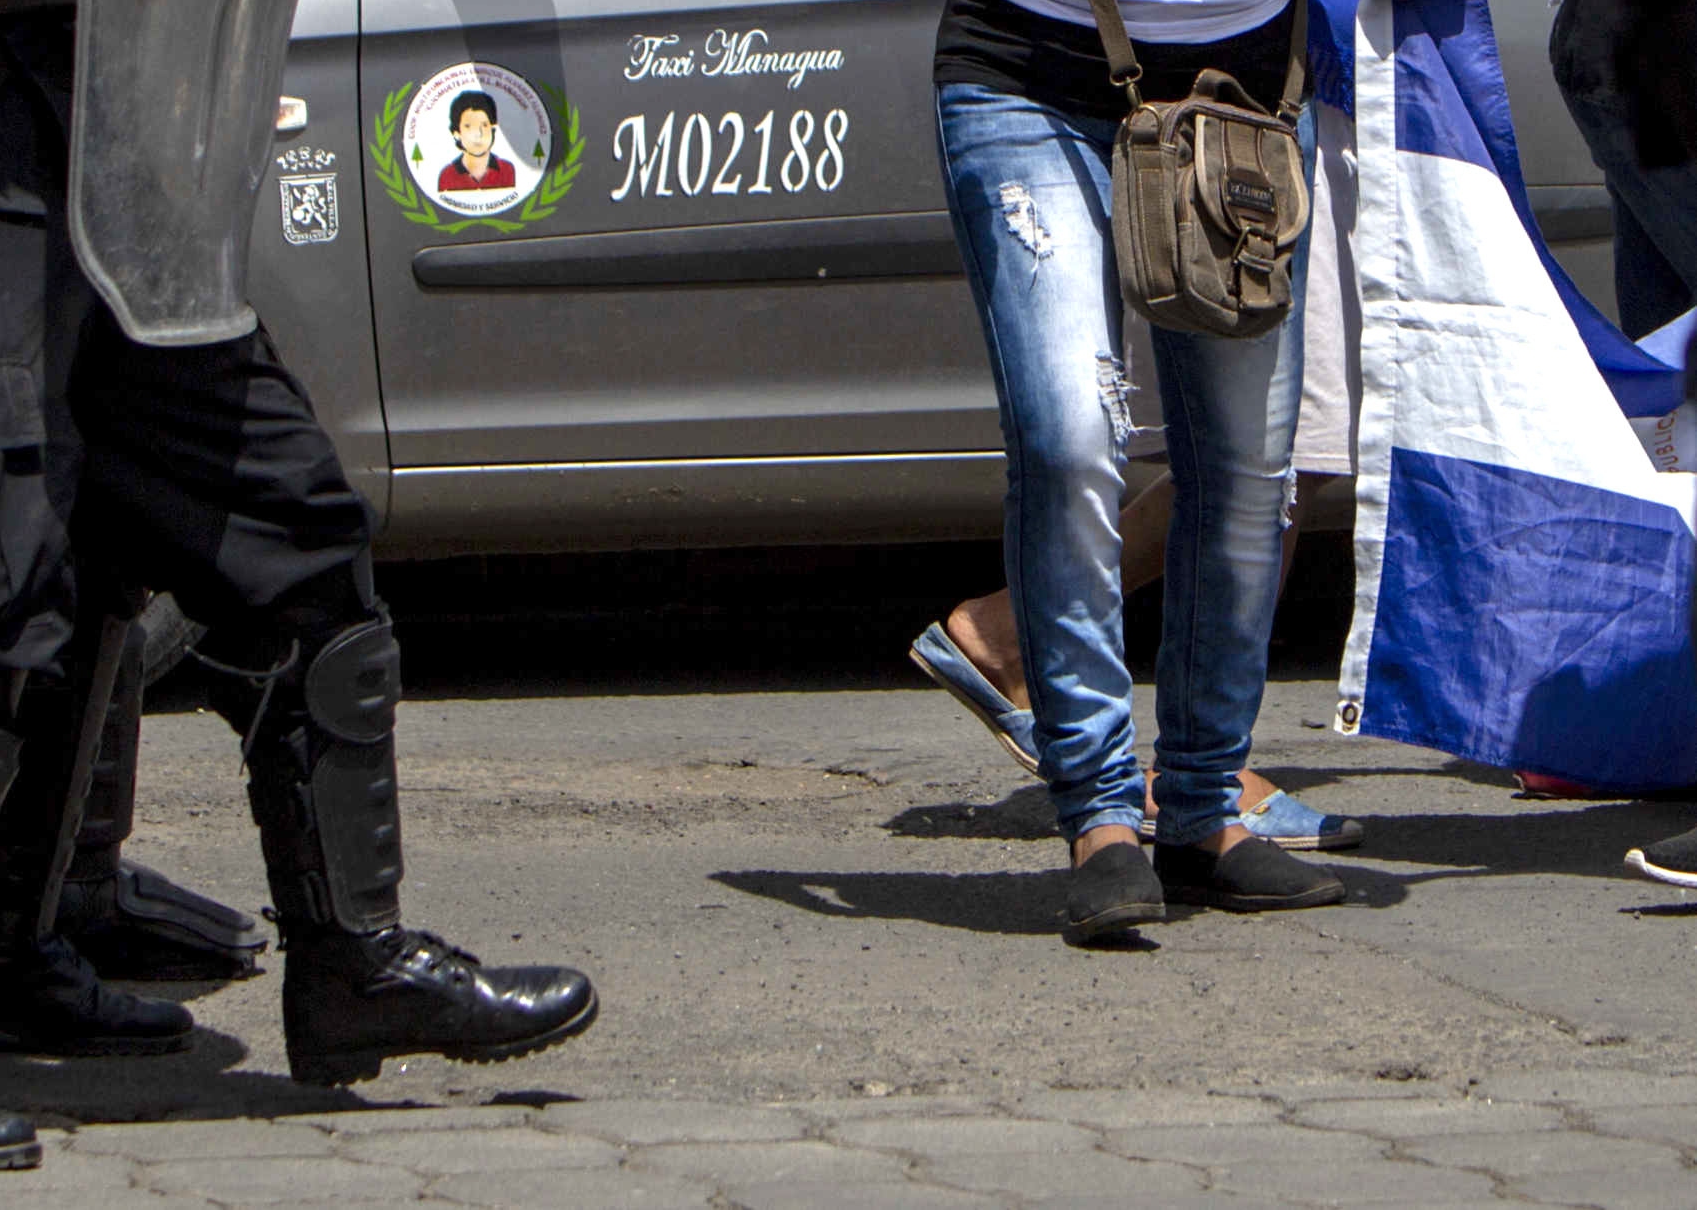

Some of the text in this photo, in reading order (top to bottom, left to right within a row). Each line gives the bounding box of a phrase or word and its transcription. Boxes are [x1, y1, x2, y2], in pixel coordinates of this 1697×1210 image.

[623, 28, 846, 90] Taxi Managua
[610, 108, 849, 201] M02188
[1655, 410, 1682, 473] PUBLIC
